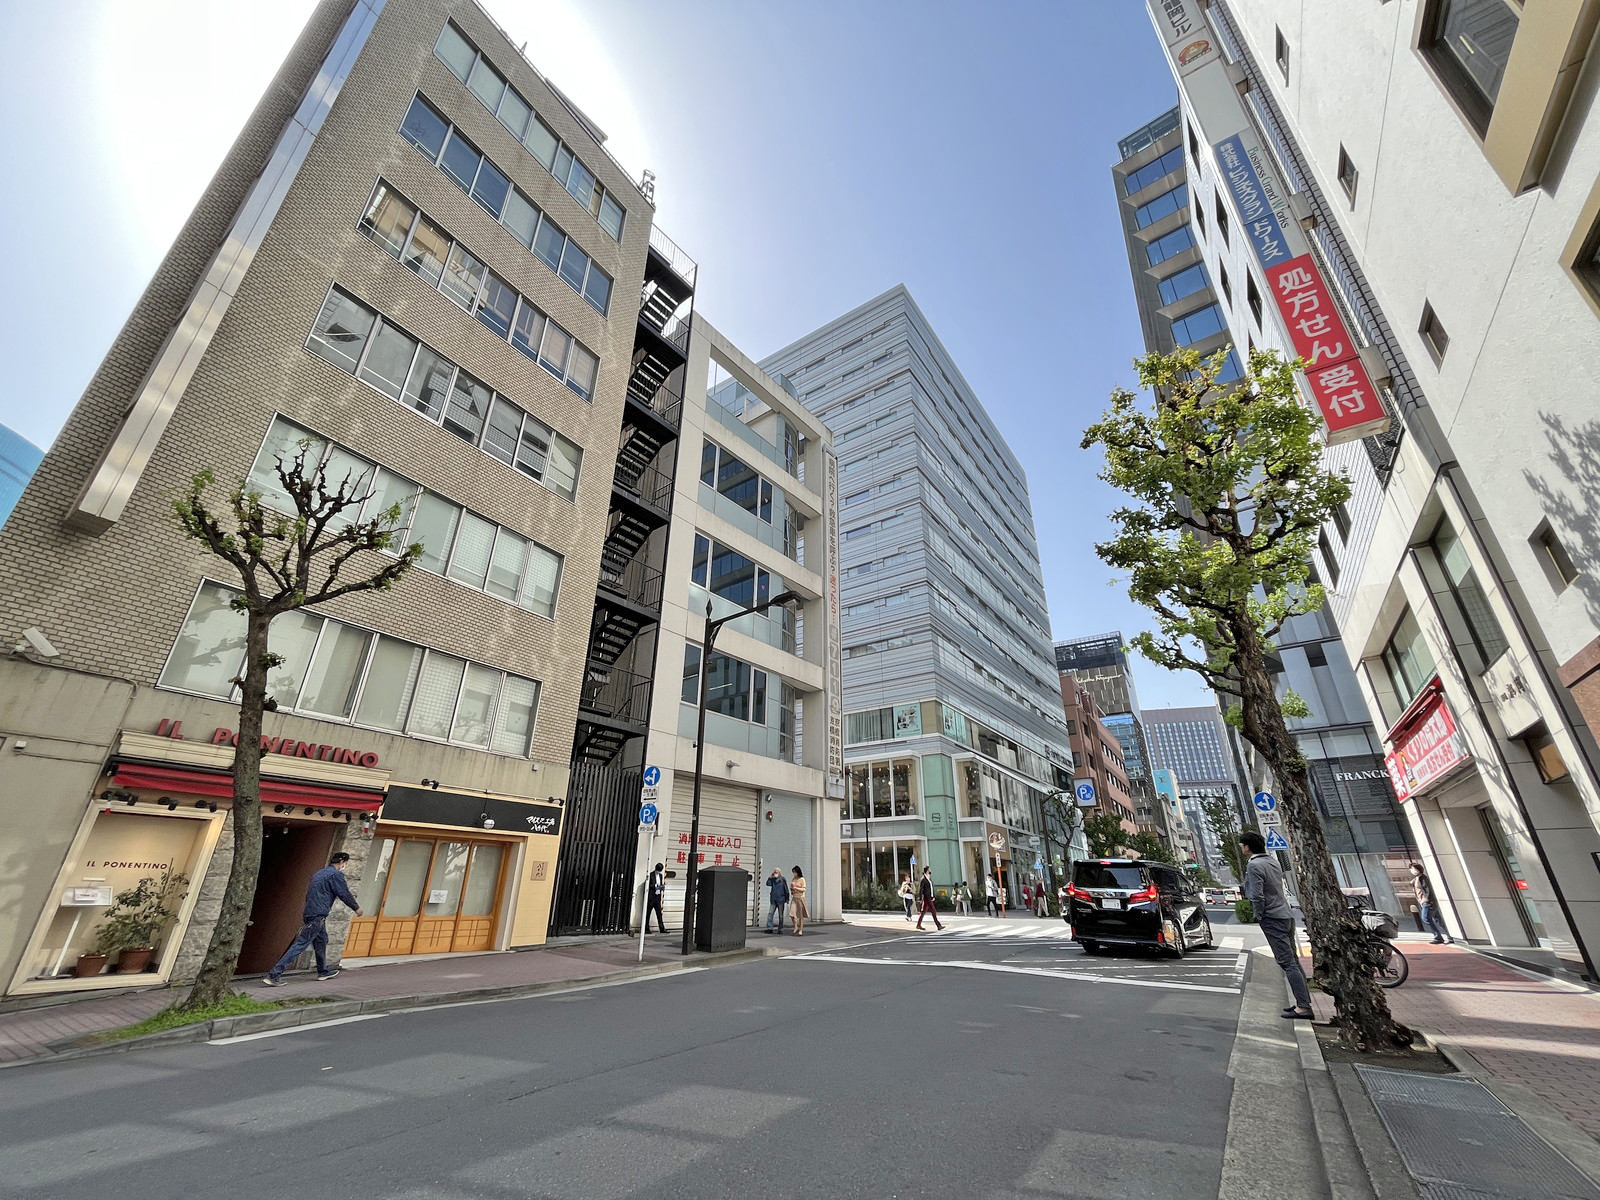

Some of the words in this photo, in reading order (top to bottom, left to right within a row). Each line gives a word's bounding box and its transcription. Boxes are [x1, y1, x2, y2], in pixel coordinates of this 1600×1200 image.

[1247, 146, 1266, 179] Business
[1262, 176, 1278, 201] Grand
[1272, 198, 1289, 230] Works
[1278, 268, 1366, 417] 処方せん受付
[156, 718, 184, 740] IL
[1336, 769, 1390, 781] FRANCK
[103, 861, 167, 870] PONENTINO
